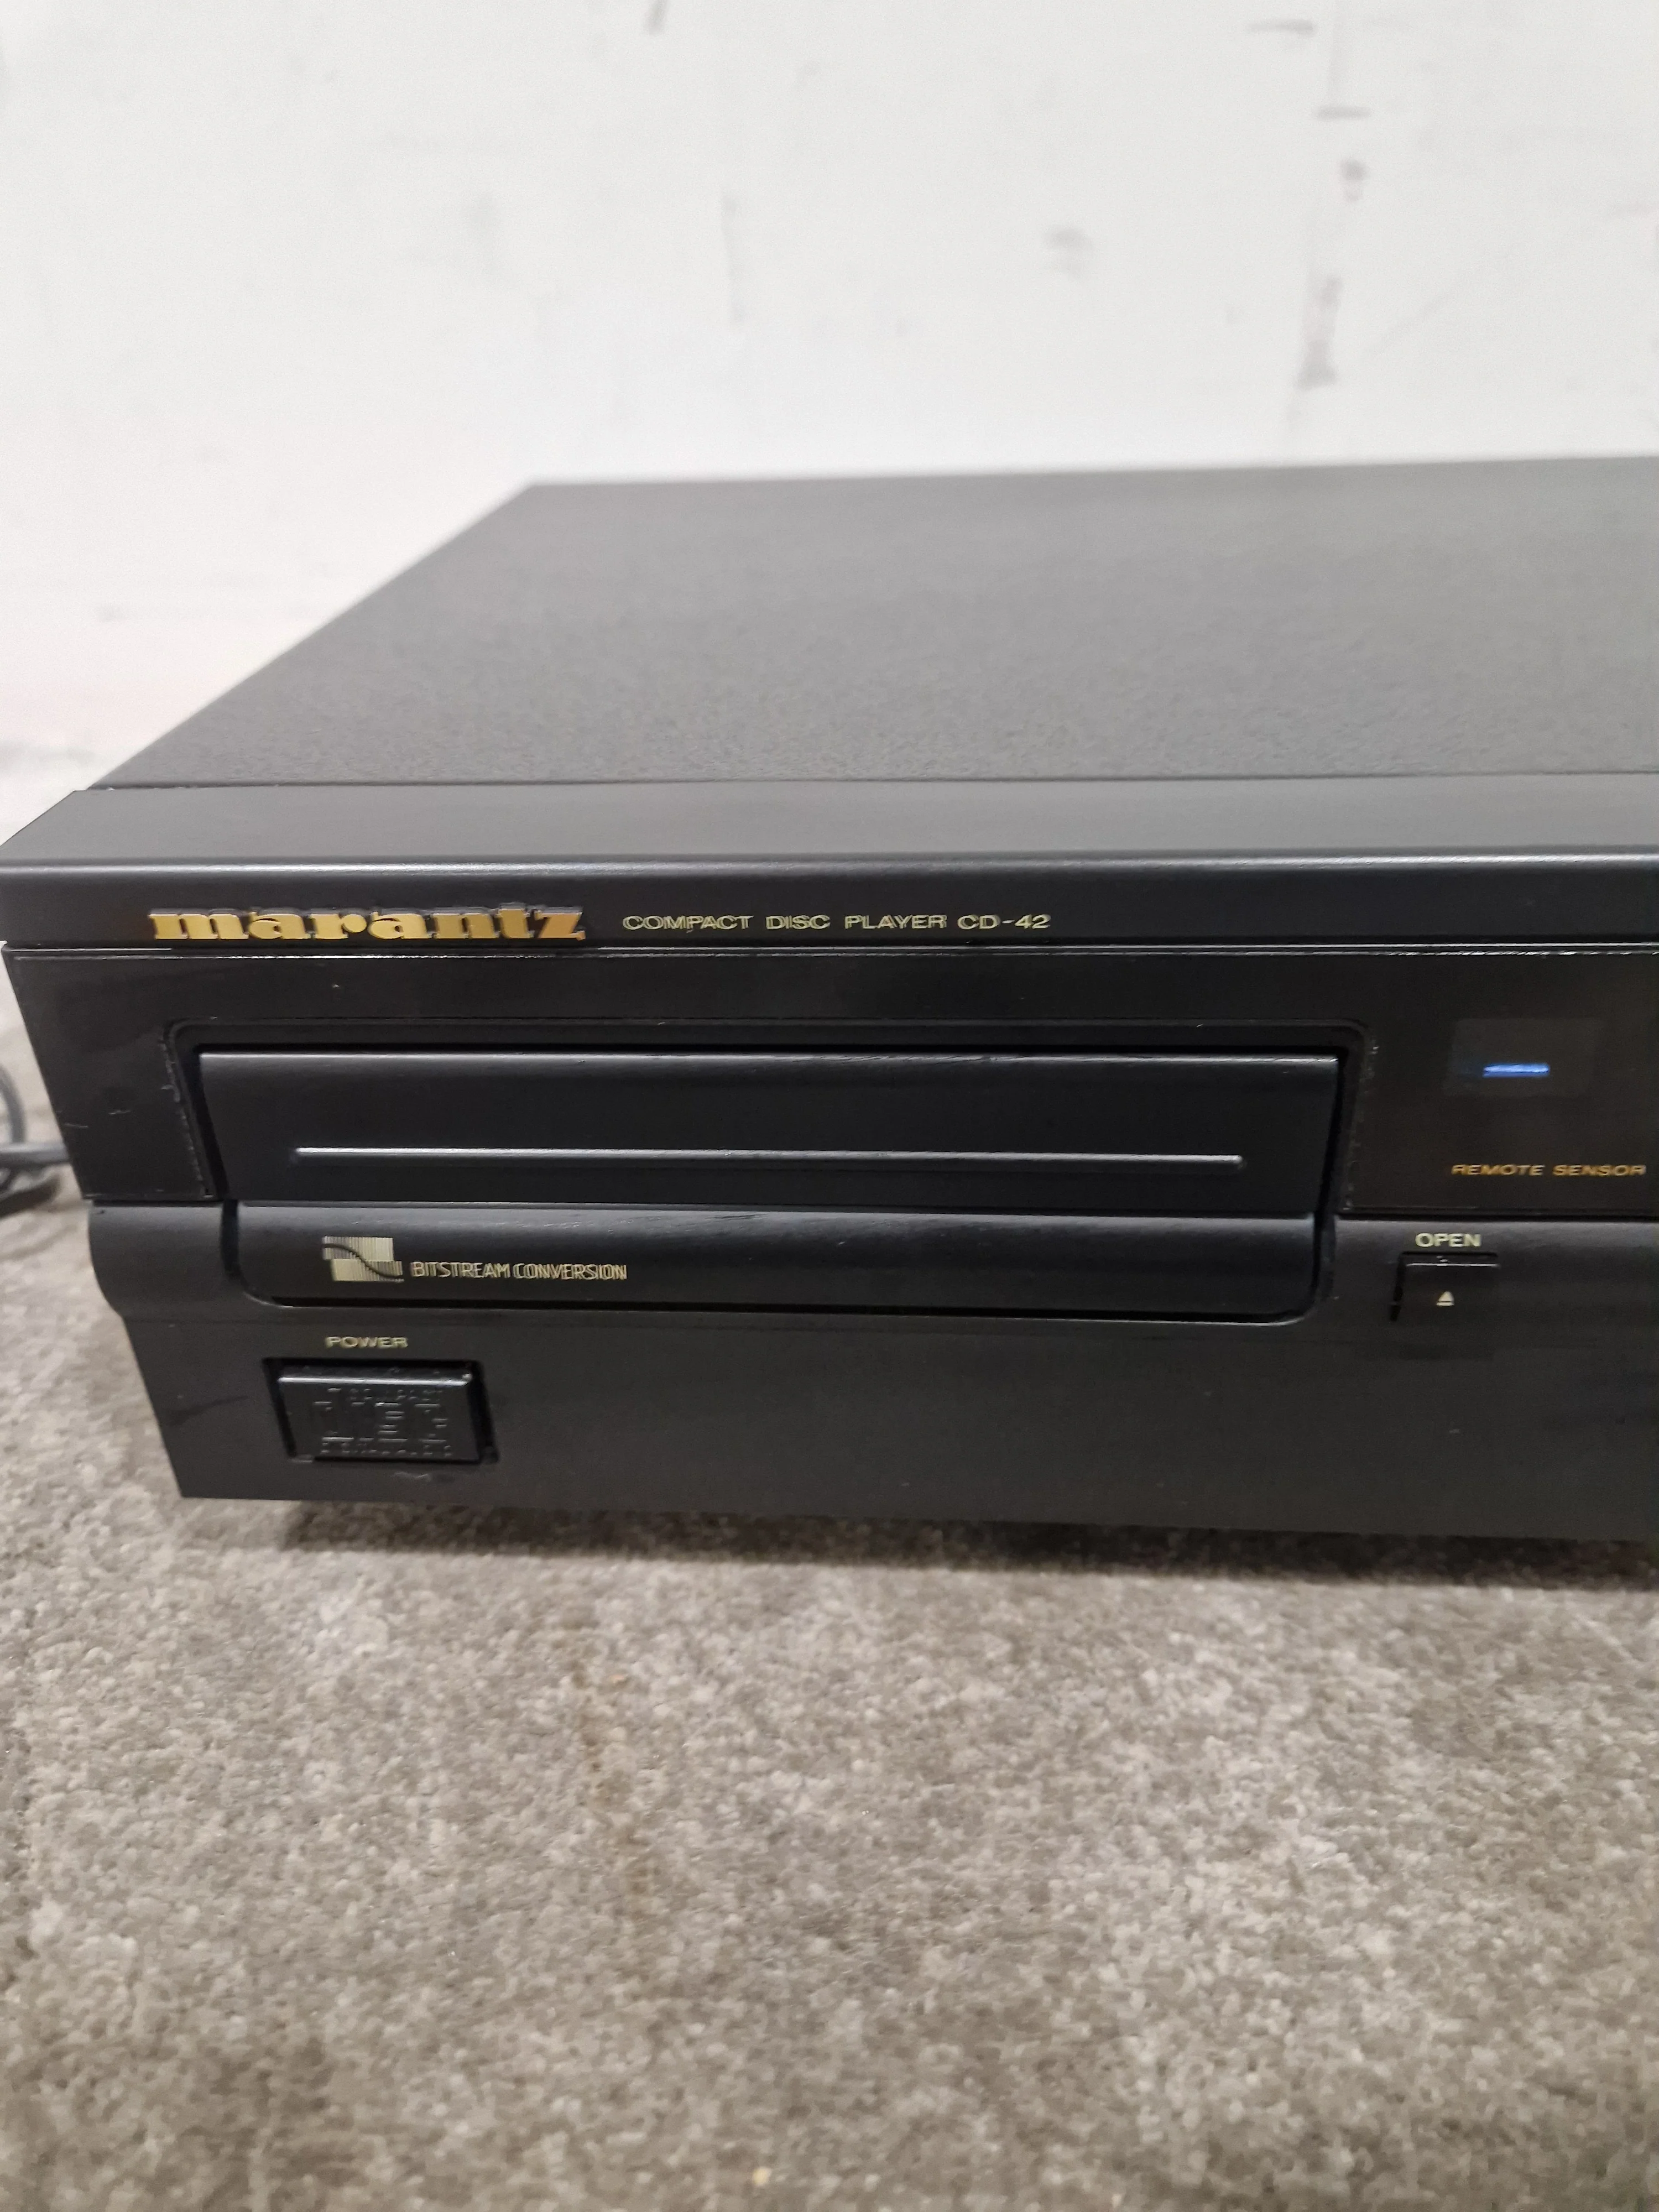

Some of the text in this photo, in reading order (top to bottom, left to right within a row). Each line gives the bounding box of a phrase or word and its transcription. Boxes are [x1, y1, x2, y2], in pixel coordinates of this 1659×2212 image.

[148, 904, 586, 941] marantz
[623, 914, 1052, 931] COMPACT DISC PLAYER CD-42
[1451, 1164, 1647, 1176] REMOTE SENSOR
[1415, 1233, 1482, 1248] OPEN
[410, 1261, 628, 1280] BITSTREAM CONVERSION
[325, 1335, 409, 1349] POWER
